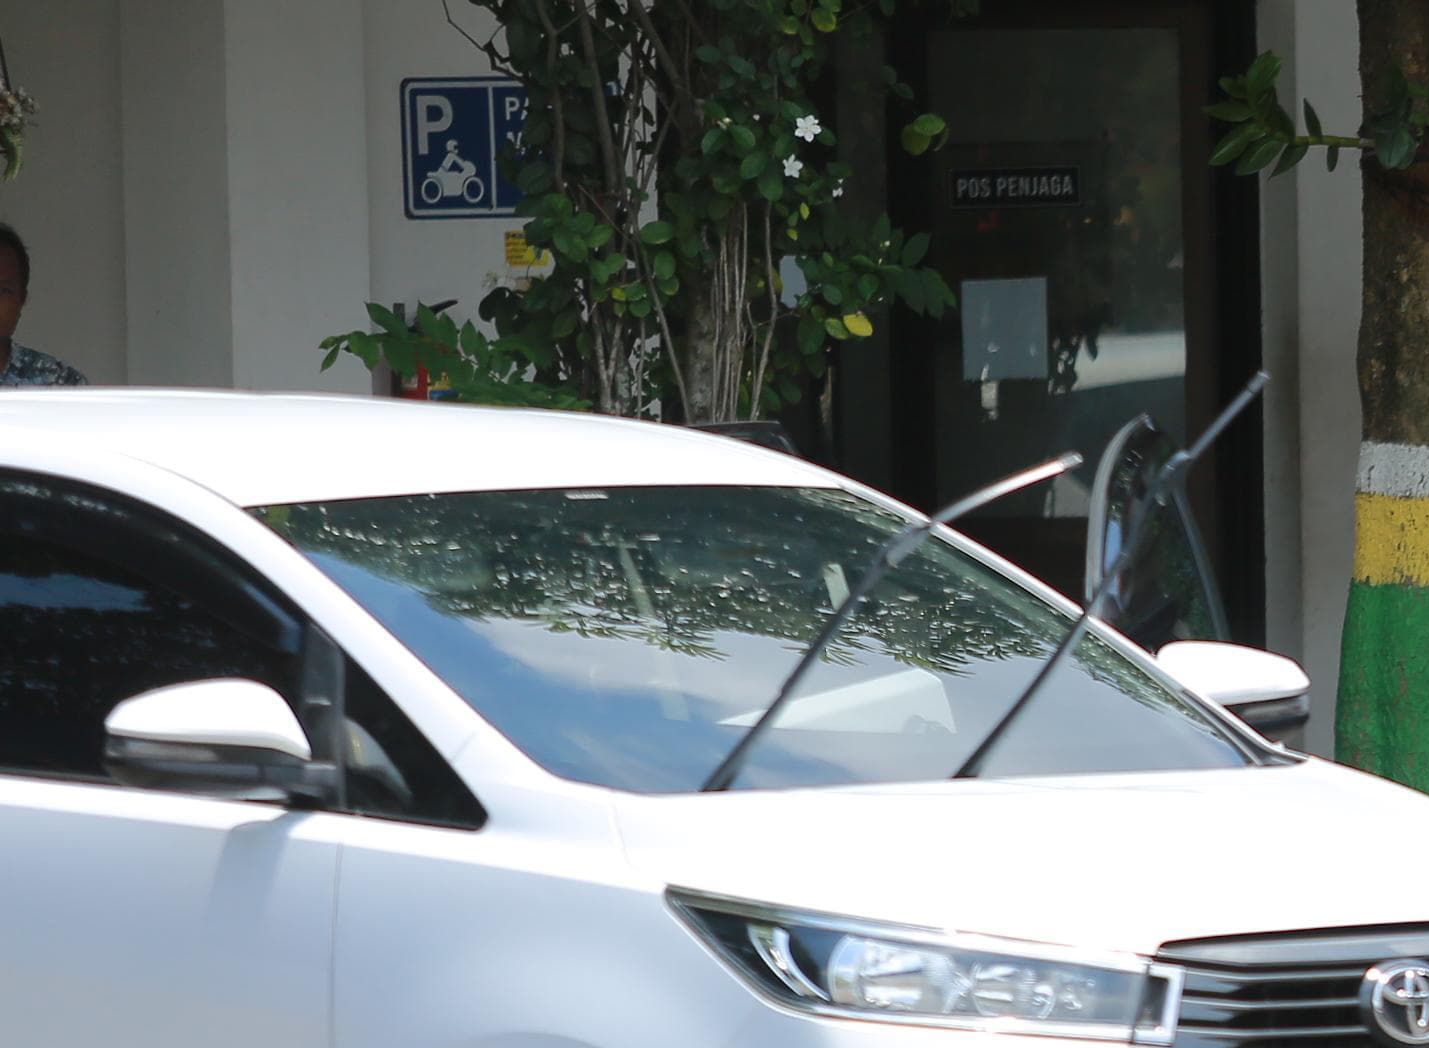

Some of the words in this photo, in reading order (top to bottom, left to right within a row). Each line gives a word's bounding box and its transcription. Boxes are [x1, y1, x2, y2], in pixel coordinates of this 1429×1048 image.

[416, 95, 453, 155] P
[957, 177, 991, 198] POS
[996, 175, 1074, 197] PENJAGA
